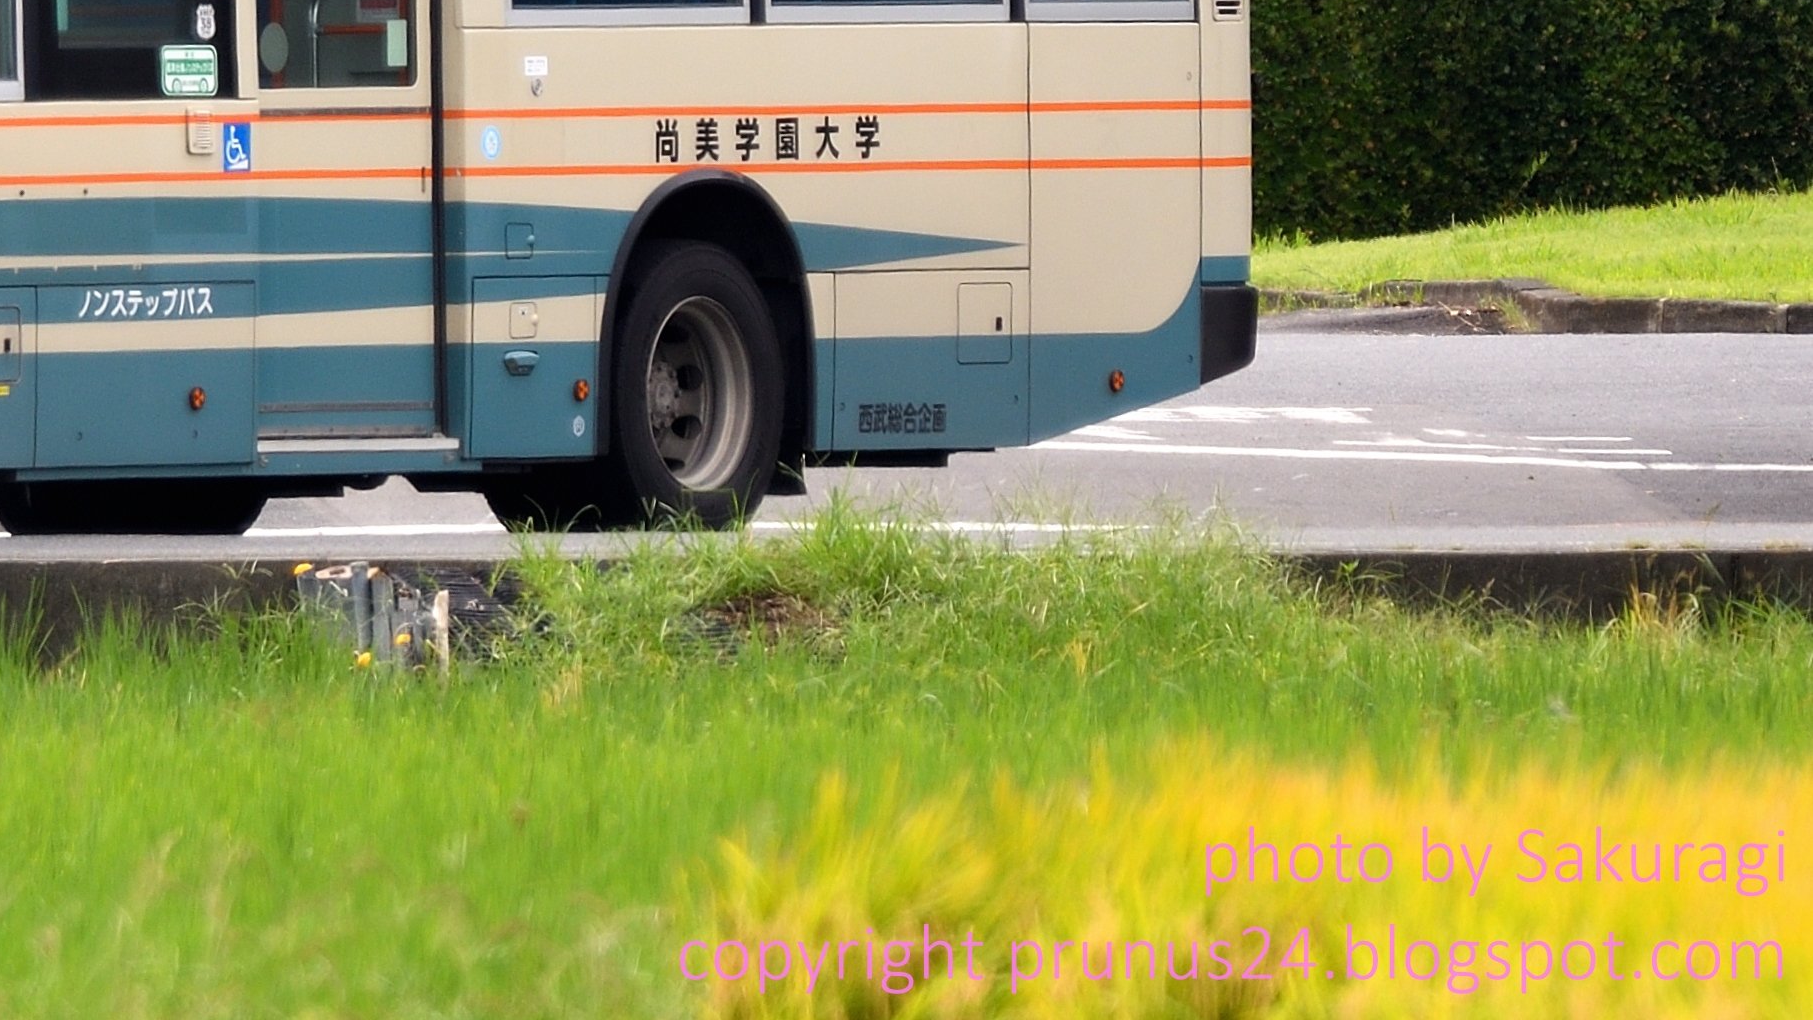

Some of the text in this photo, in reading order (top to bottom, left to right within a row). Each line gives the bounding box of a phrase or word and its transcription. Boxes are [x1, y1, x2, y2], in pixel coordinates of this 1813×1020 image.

[655, 115, 880, 163] 尚美学園大学
[78, 287, 213, 318] ノンステップバス
[858, 402, 947, 434] 西武総合企画
